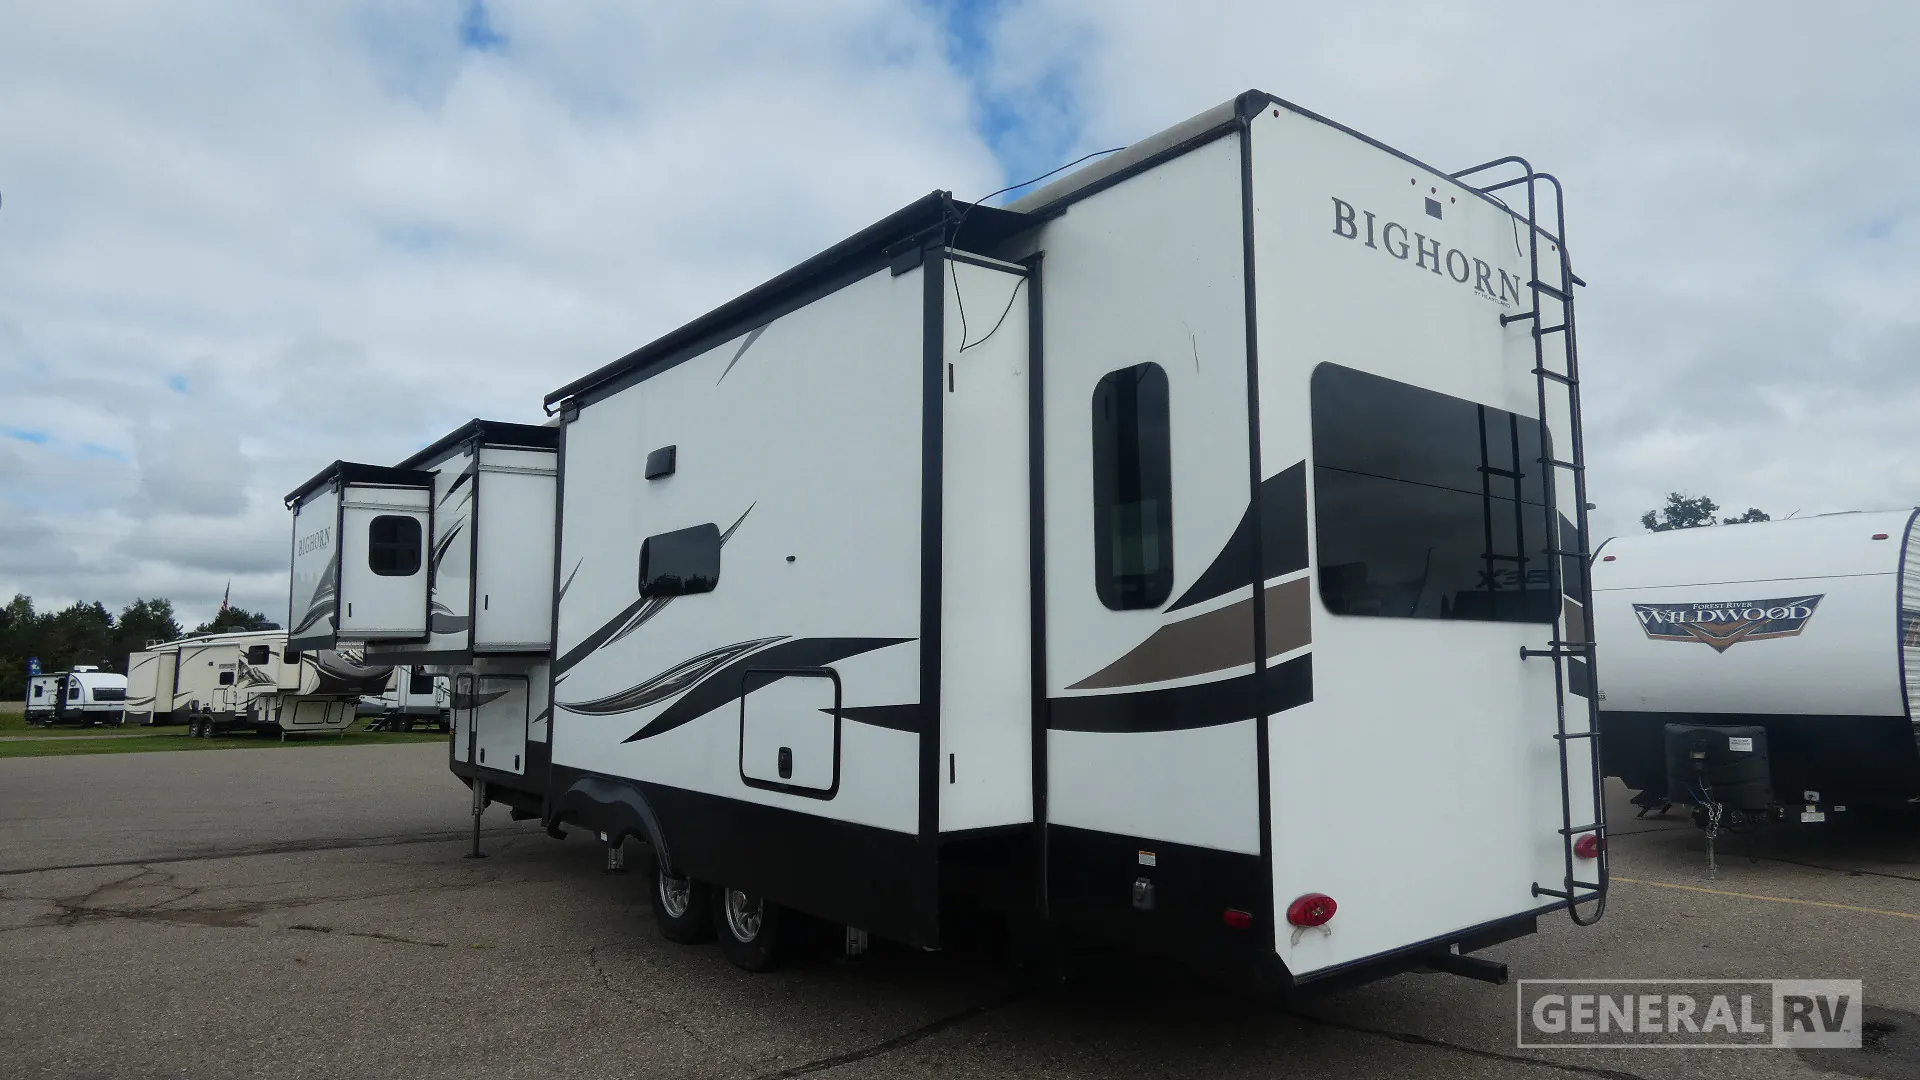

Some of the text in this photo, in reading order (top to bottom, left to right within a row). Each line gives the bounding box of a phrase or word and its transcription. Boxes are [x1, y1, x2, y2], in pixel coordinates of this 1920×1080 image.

[1331, 196, 1521, 307] BIGHORN
[298, 526, 331, 557] BIGHORN
[1636, 605, 1813, 625] WILDWOOD
